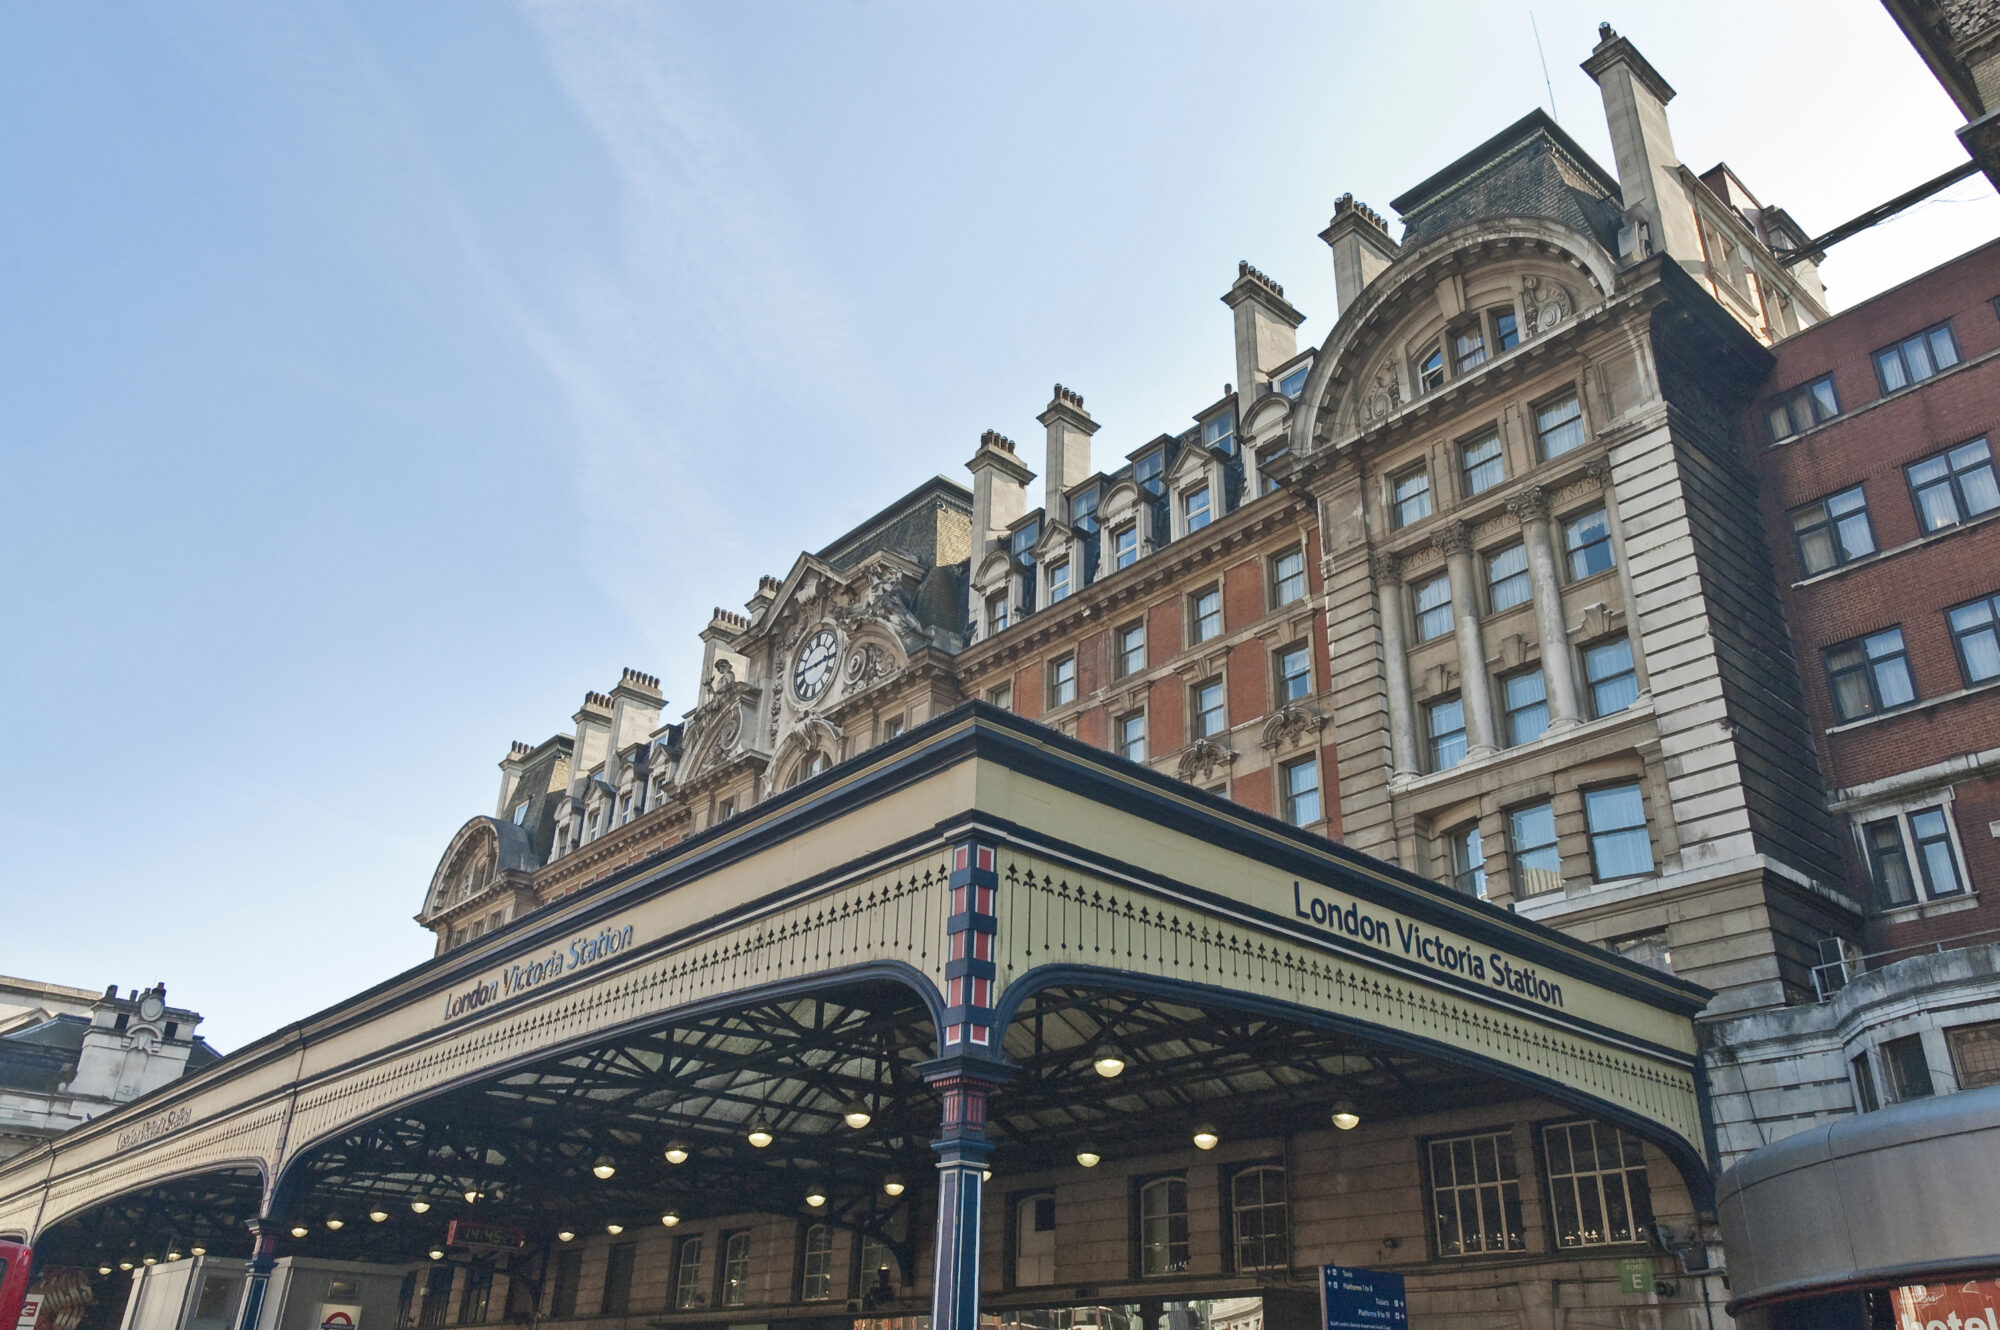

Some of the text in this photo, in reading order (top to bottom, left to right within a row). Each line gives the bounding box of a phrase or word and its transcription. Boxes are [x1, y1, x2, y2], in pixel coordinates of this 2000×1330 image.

[443, 924, 633, 1020] London Victoria Station
[1293, 881, 1564, 1007] London Victoria Station
[1632, 1274, 1643, 1289] E
